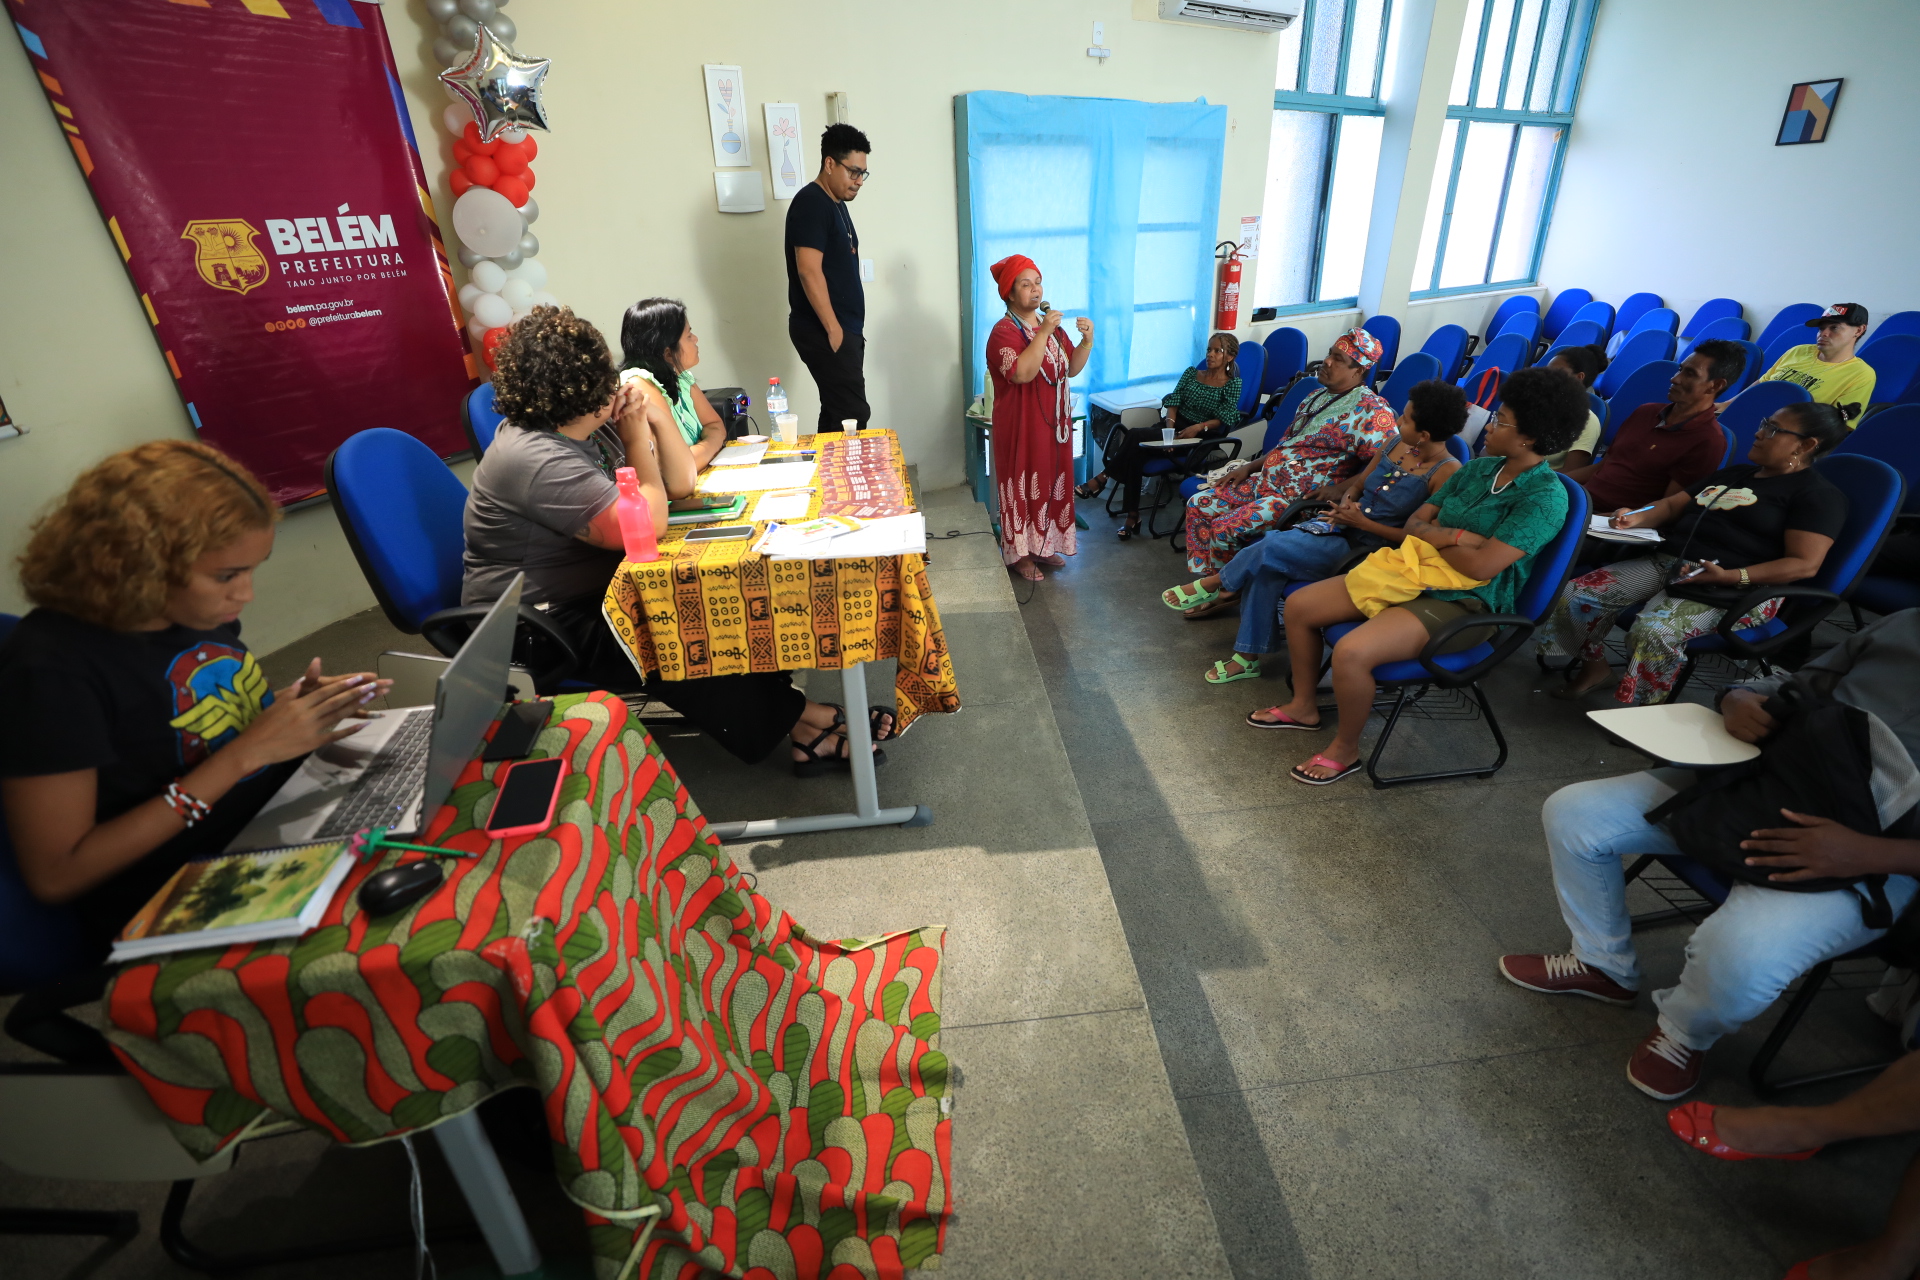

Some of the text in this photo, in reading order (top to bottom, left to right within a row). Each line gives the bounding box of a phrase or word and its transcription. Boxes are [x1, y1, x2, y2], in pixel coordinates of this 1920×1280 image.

[265, 202, 399, 255] BELÉM
[280, 253, 404, 274] PREFEITURA
[287, 269, 407, 288] TAMO JUNTO POR BELÉM
[286, 299, 354, 314] belem.pa.gov.br
[309, 308, 382, 326] @prefeiturabelem
